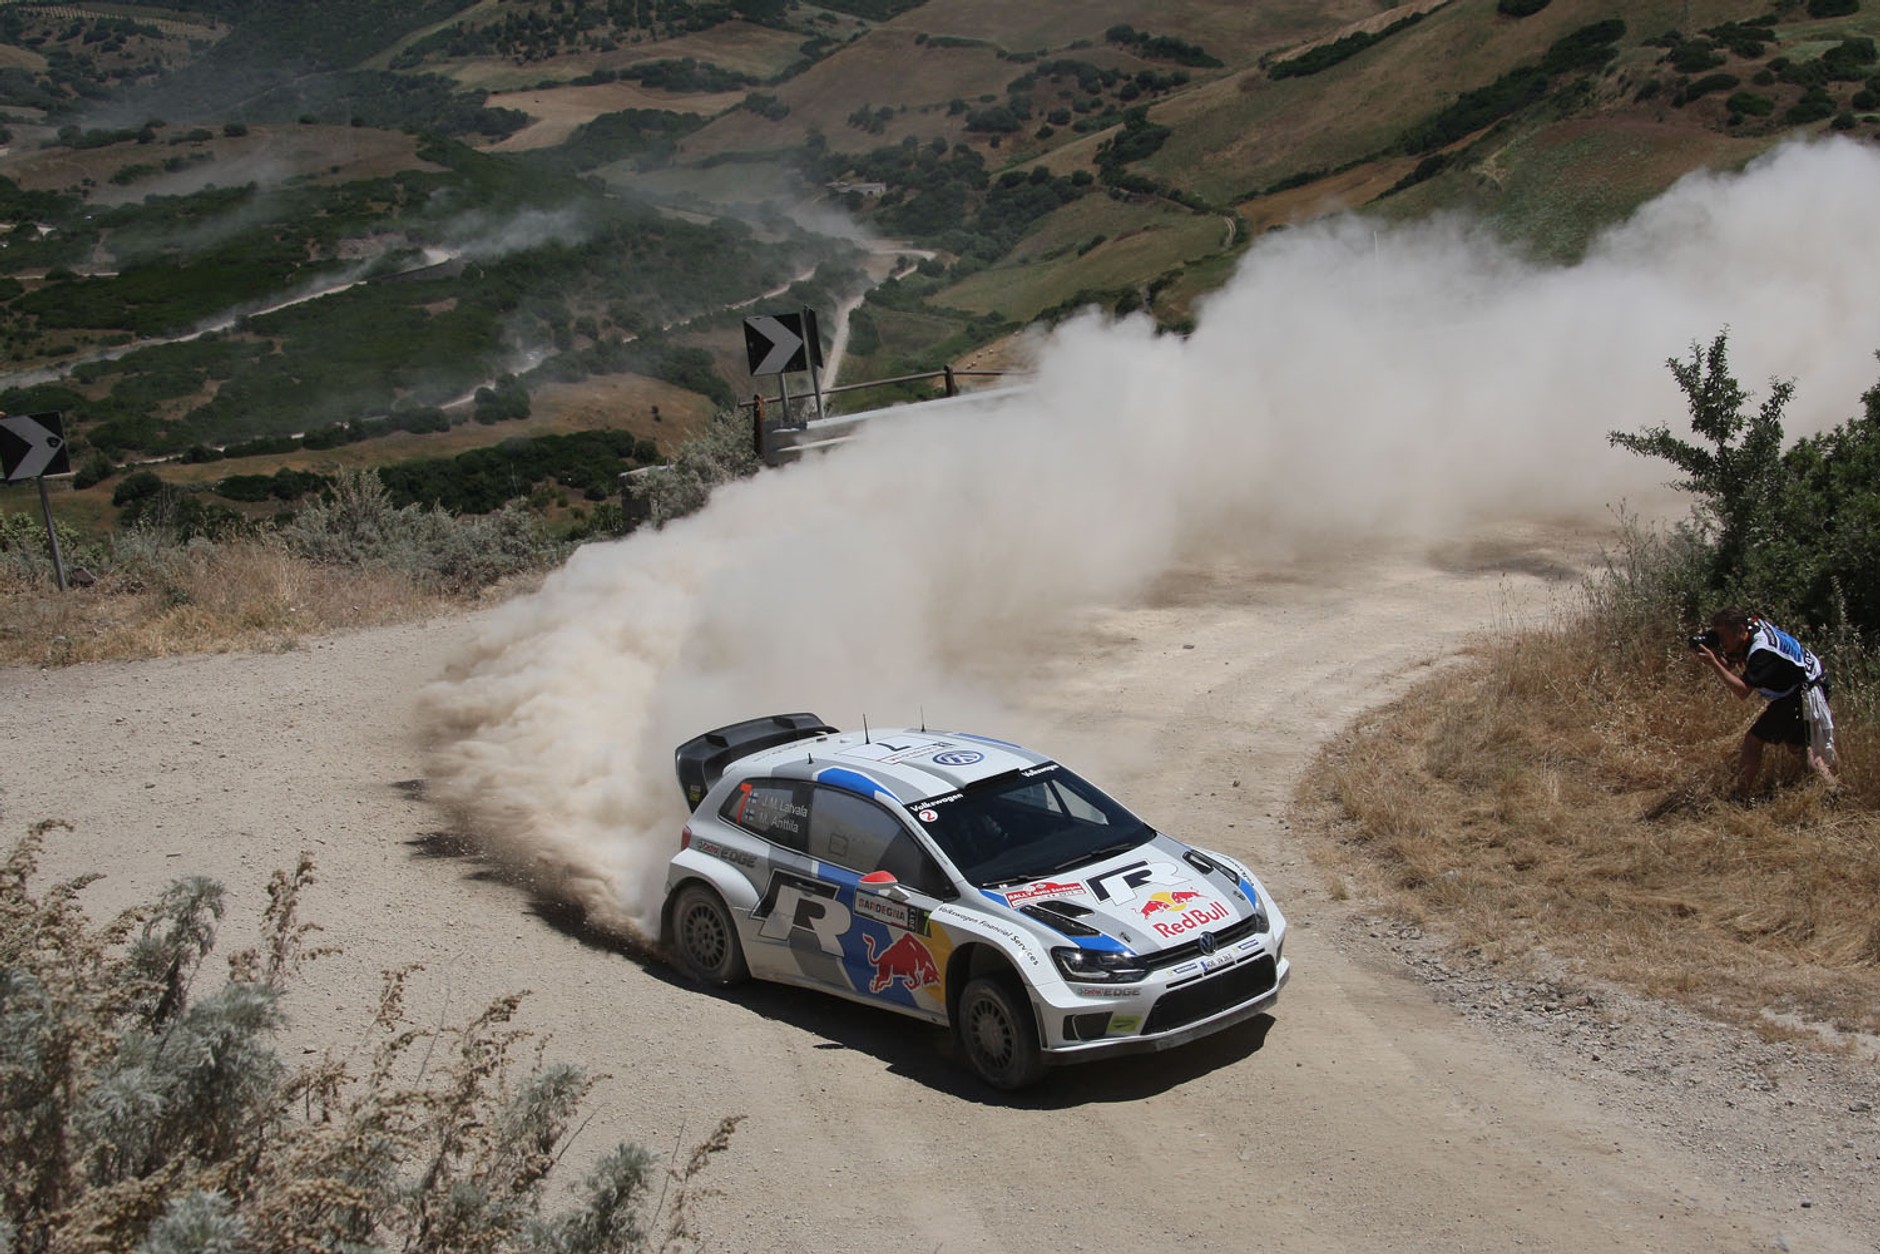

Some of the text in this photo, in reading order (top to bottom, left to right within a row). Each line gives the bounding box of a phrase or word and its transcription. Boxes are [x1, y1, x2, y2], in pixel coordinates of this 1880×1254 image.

[910, 792, 964, 813] Volkswagen
[922, 811, 936, 822] 2
[1007, 891, 1032, 901] RALLY
[756, 870, 851, 958] R
[858, 898, 906, 920] SARDEGNA
[1153, 901, 1230, 938] Red Bull
[938, 905, 1039, 967] Volkswagen Financial Services
[1103, 987, 1143, 998] EDGE
